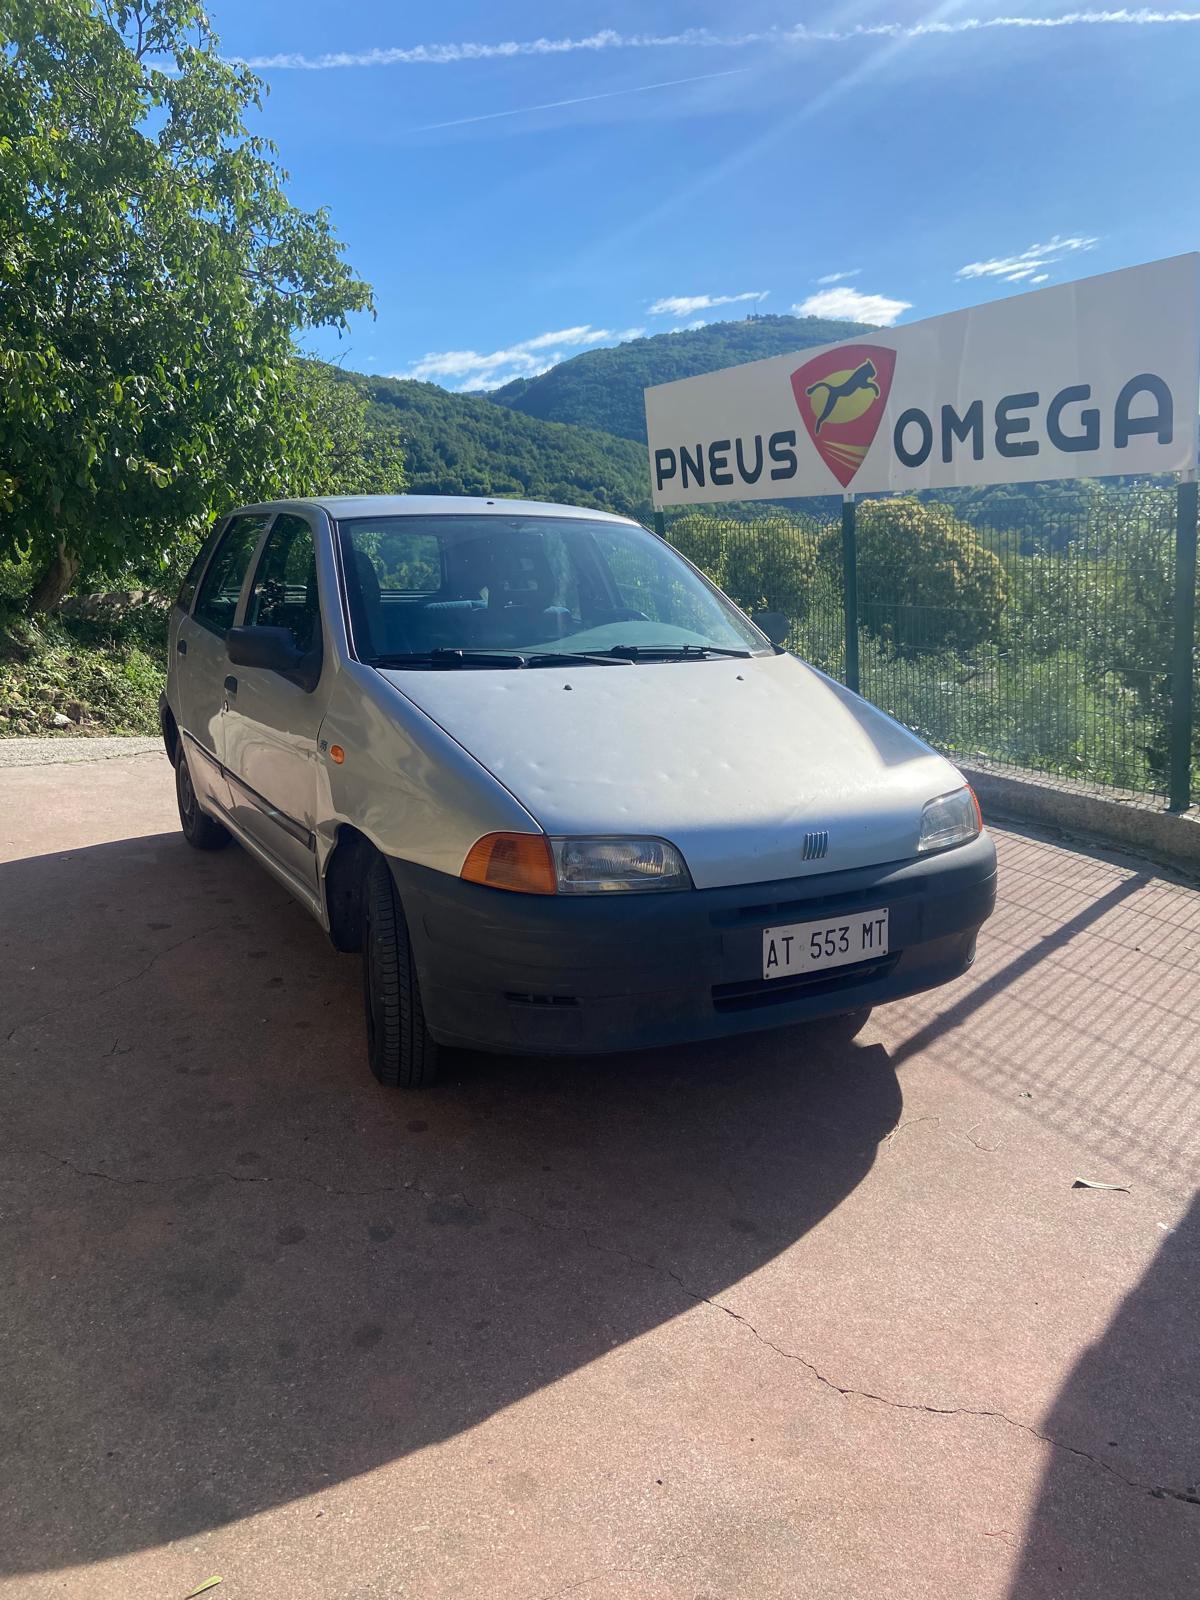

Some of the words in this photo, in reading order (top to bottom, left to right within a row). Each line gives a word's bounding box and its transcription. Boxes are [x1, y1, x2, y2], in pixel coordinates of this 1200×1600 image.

[655, 429, 798, 491] PNEUS
[893, 373, 1174, 468] OMEGA
[766, 936, 794, 969] AT
[810, 926, 850, 959] 553
[862, 919, 886, 949] MT
